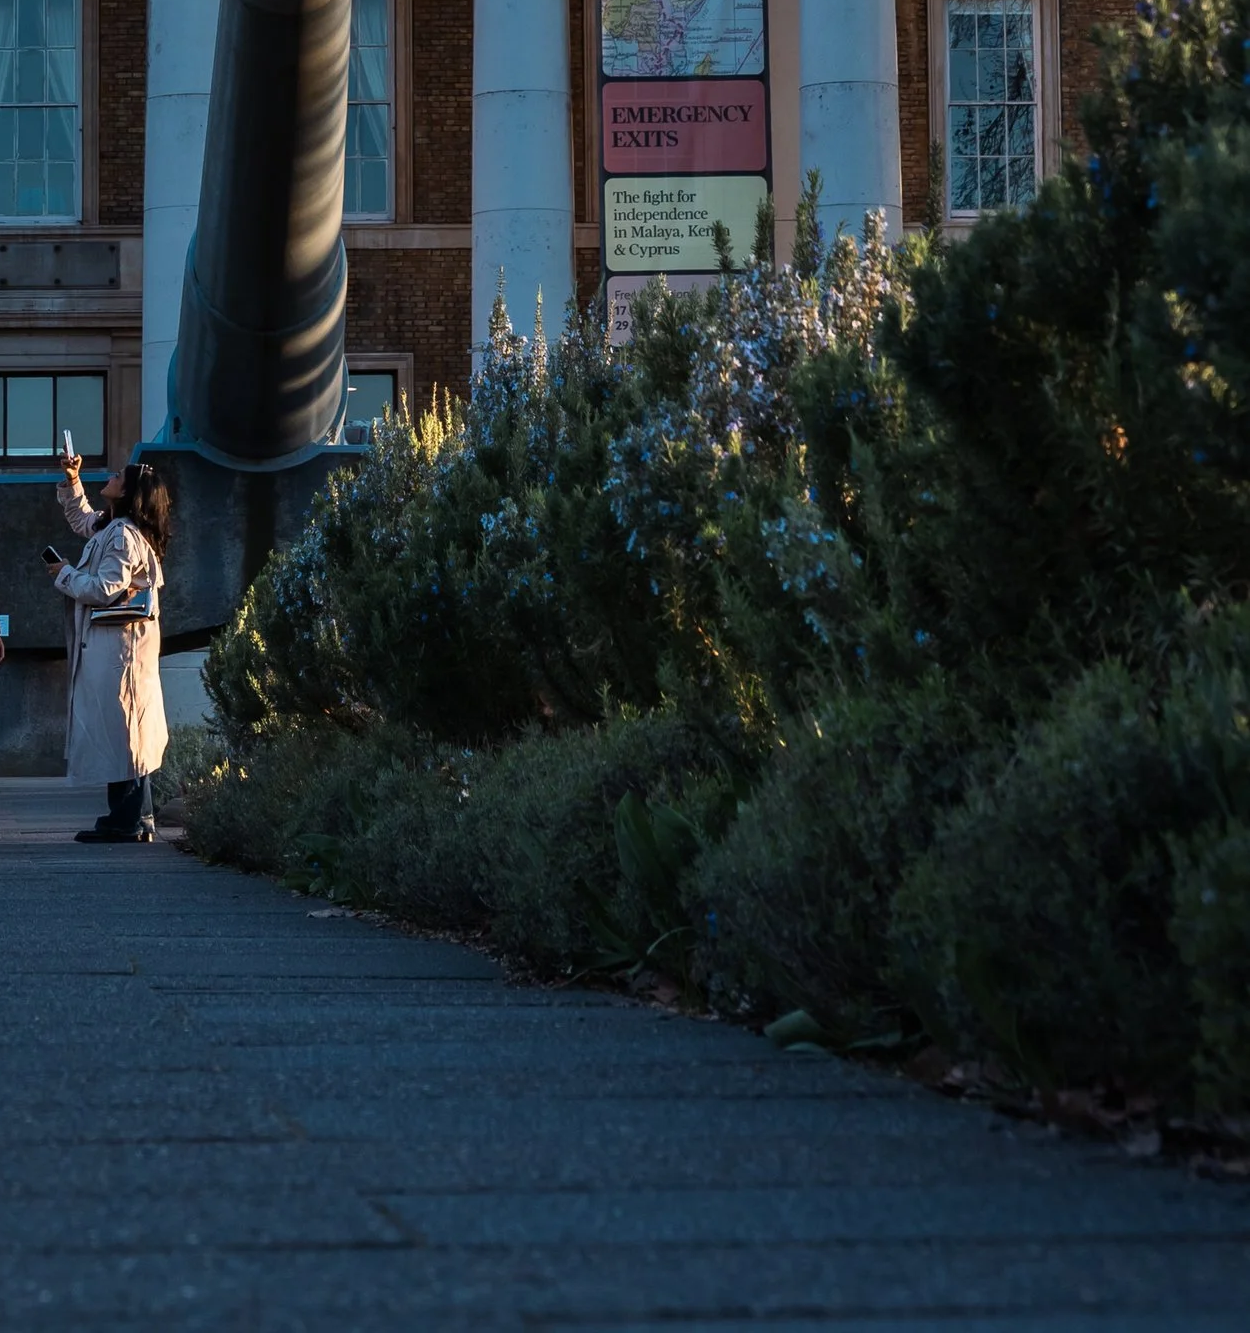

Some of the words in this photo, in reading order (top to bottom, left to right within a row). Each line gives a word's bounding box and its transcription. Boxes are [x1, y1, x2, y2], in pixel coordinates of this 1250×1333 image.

[611, 105, 753, 124] EMERGENCY
[612, 130, 679, 148] EXITS
[613, 191, 640, 204] The
[643, 190, 674, 206] fight
[677, 190, 697, 203] for
[613, 208, 708, 223] independence
[614, 226, 627, 238] in
[631, 225, 684, 240] Malaya,
[688, 225, 730, 238] Kena
[614, 244, 626, 256] &
[629, 243, 680, 258] Cyprus
[614, 290, 633, 300] Fre
[614, 306, 627, 315] 17
[615, 321, 629, 330] 29
